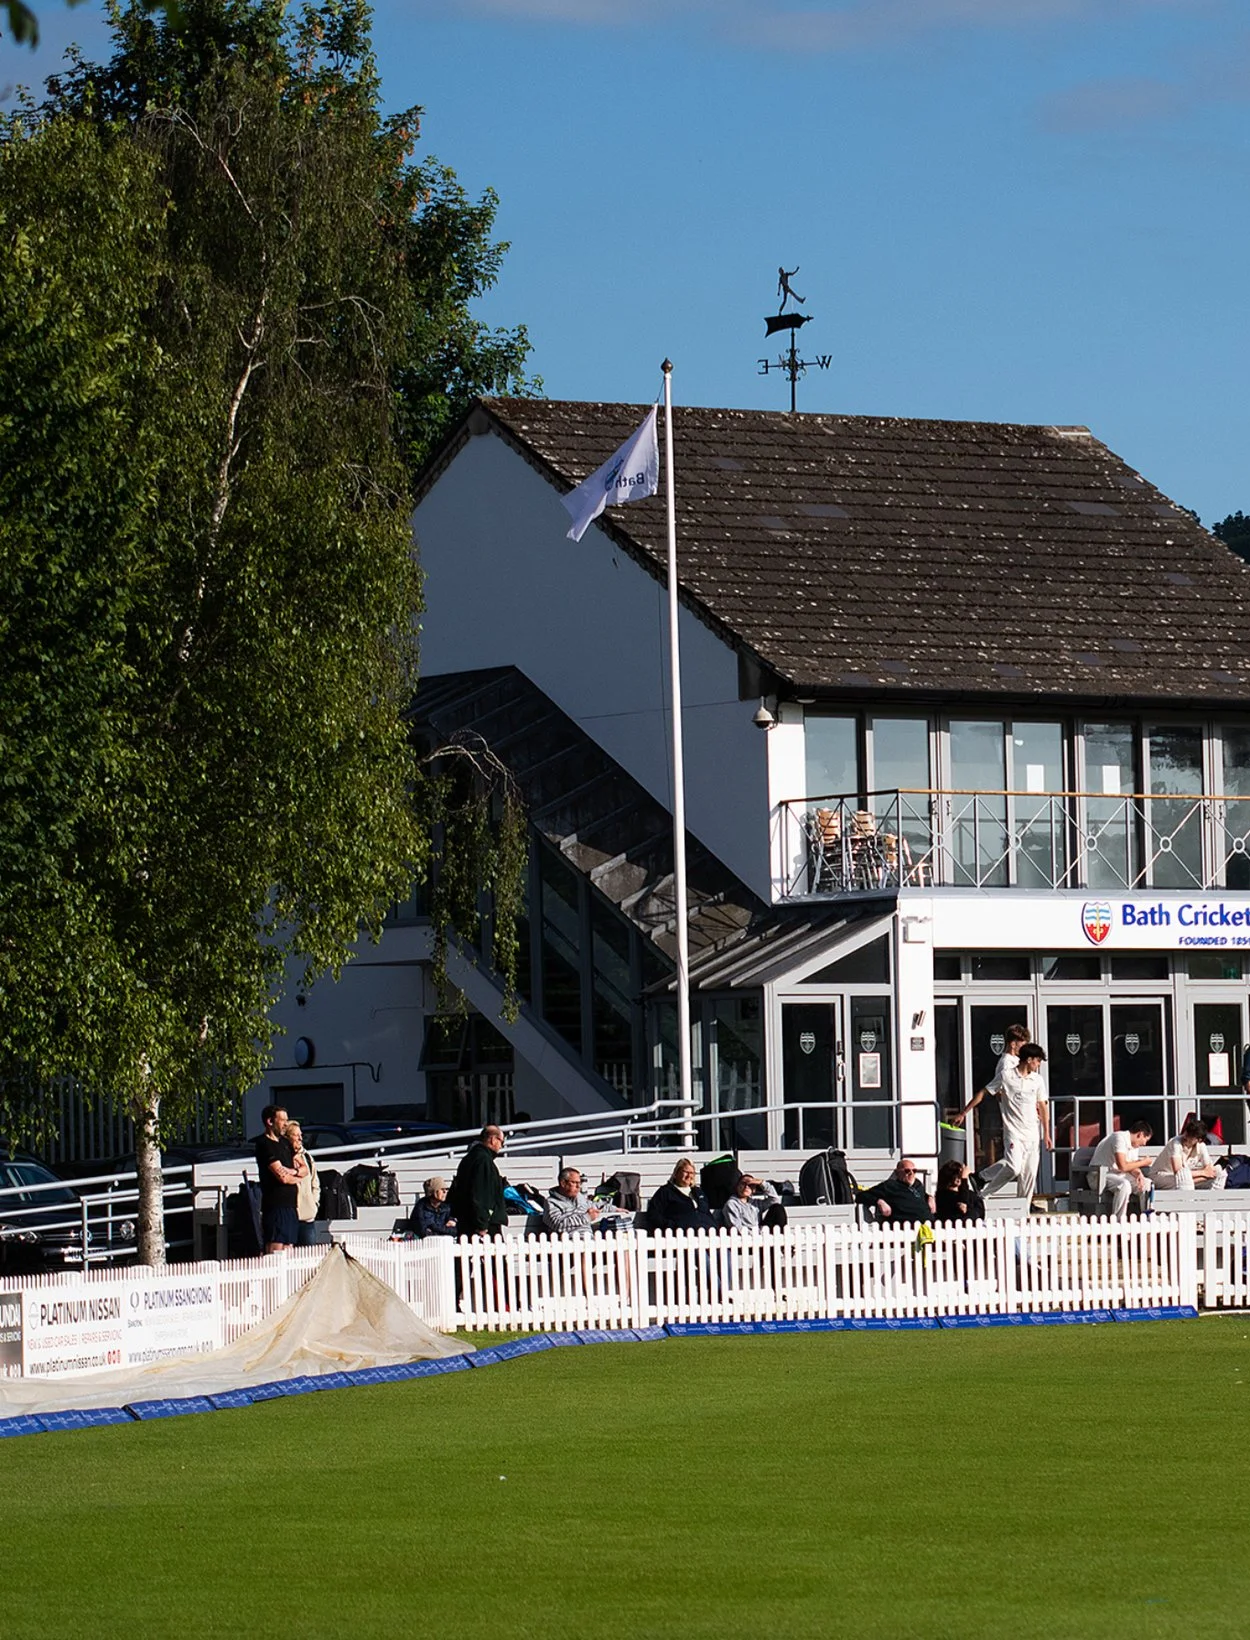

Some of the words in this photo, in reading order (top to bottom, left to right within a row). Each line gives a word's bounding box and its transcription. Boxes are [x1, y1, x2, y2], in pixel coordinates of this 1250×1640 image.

[815, 355, 832, 370] W
[1122, 903, 1170, 926] Bath
[1178, 936, 1228, 946] FOUNDED
[144, 1289, 174, 1310] PLATINUM
[175, 1286, 212, 1307] SSANGYONG
[40, 1300, 87, 1326] PLATINUM
[89, 1297, 121, 1321] NISSAN
[29, 1352, 107, 1376] www.platinumnissan.co.uk
